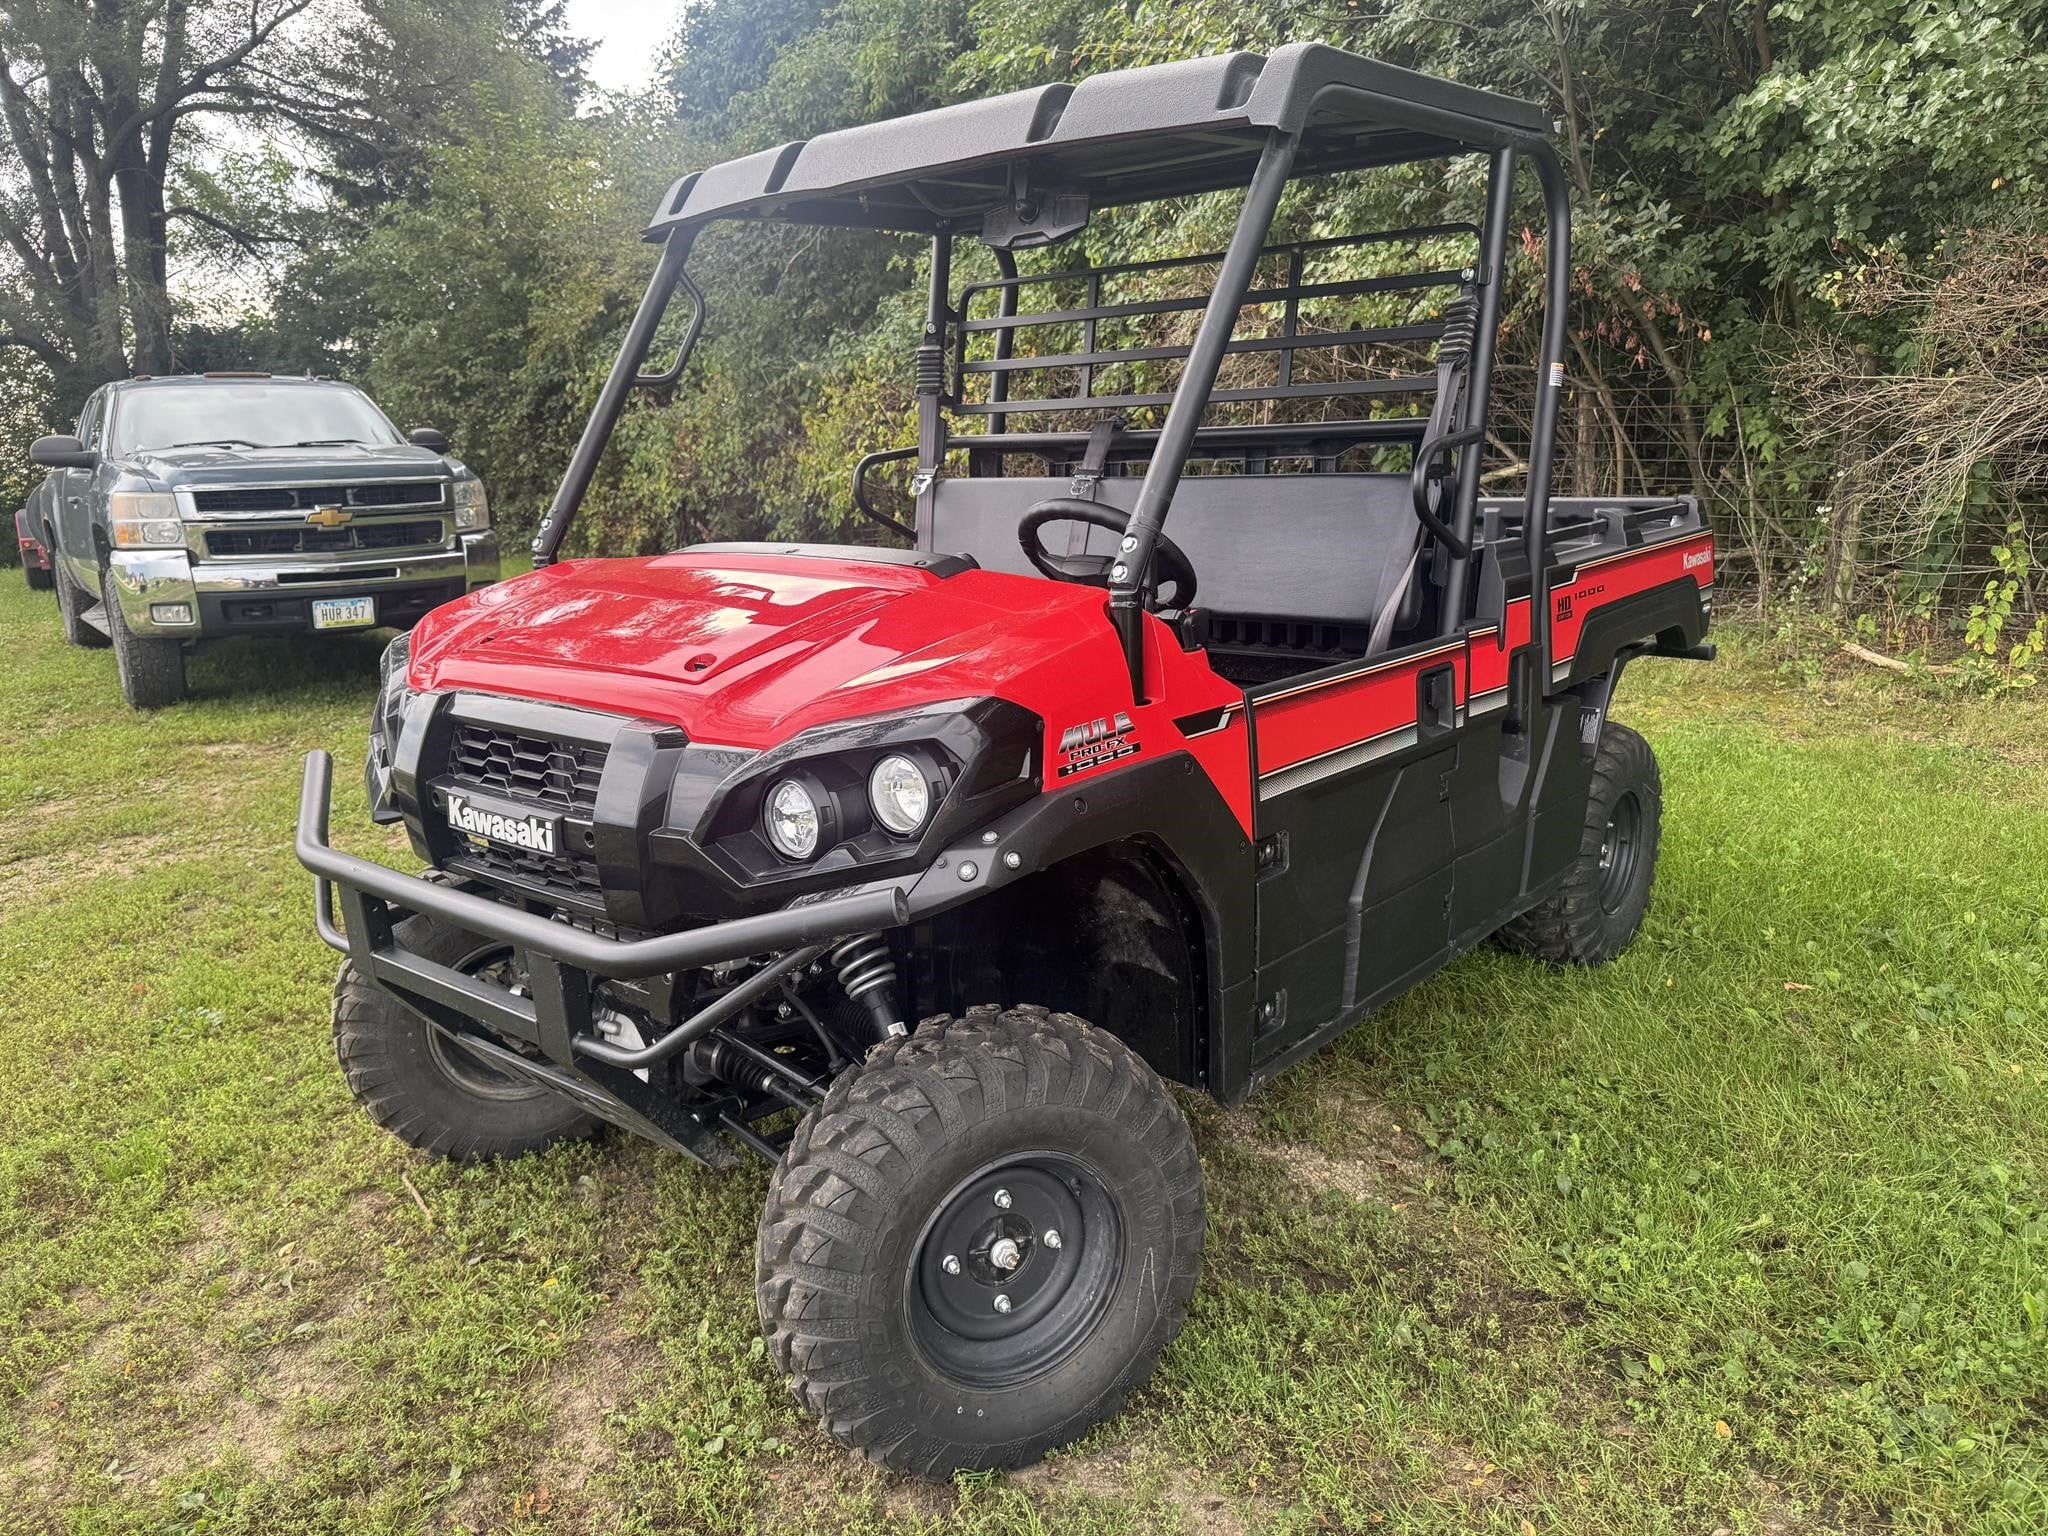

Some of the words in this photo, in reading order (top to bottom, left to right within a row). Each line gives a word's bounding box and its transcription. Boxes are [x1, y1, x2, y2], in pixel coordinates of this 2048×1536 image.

[1682, 545, 1711, 570] Kawasaki
[321, 607, 342, 621] HUR
[345, 605, 365, 619] 347
[1557, 595, 1572, 613] HD
[1574, 585, 1605, 600] 1000
[1058, 711, 1136, 755] MULE
[1065, 745, 1134, 774] 1000
[447, 795, 554, 853] Kawasaki
